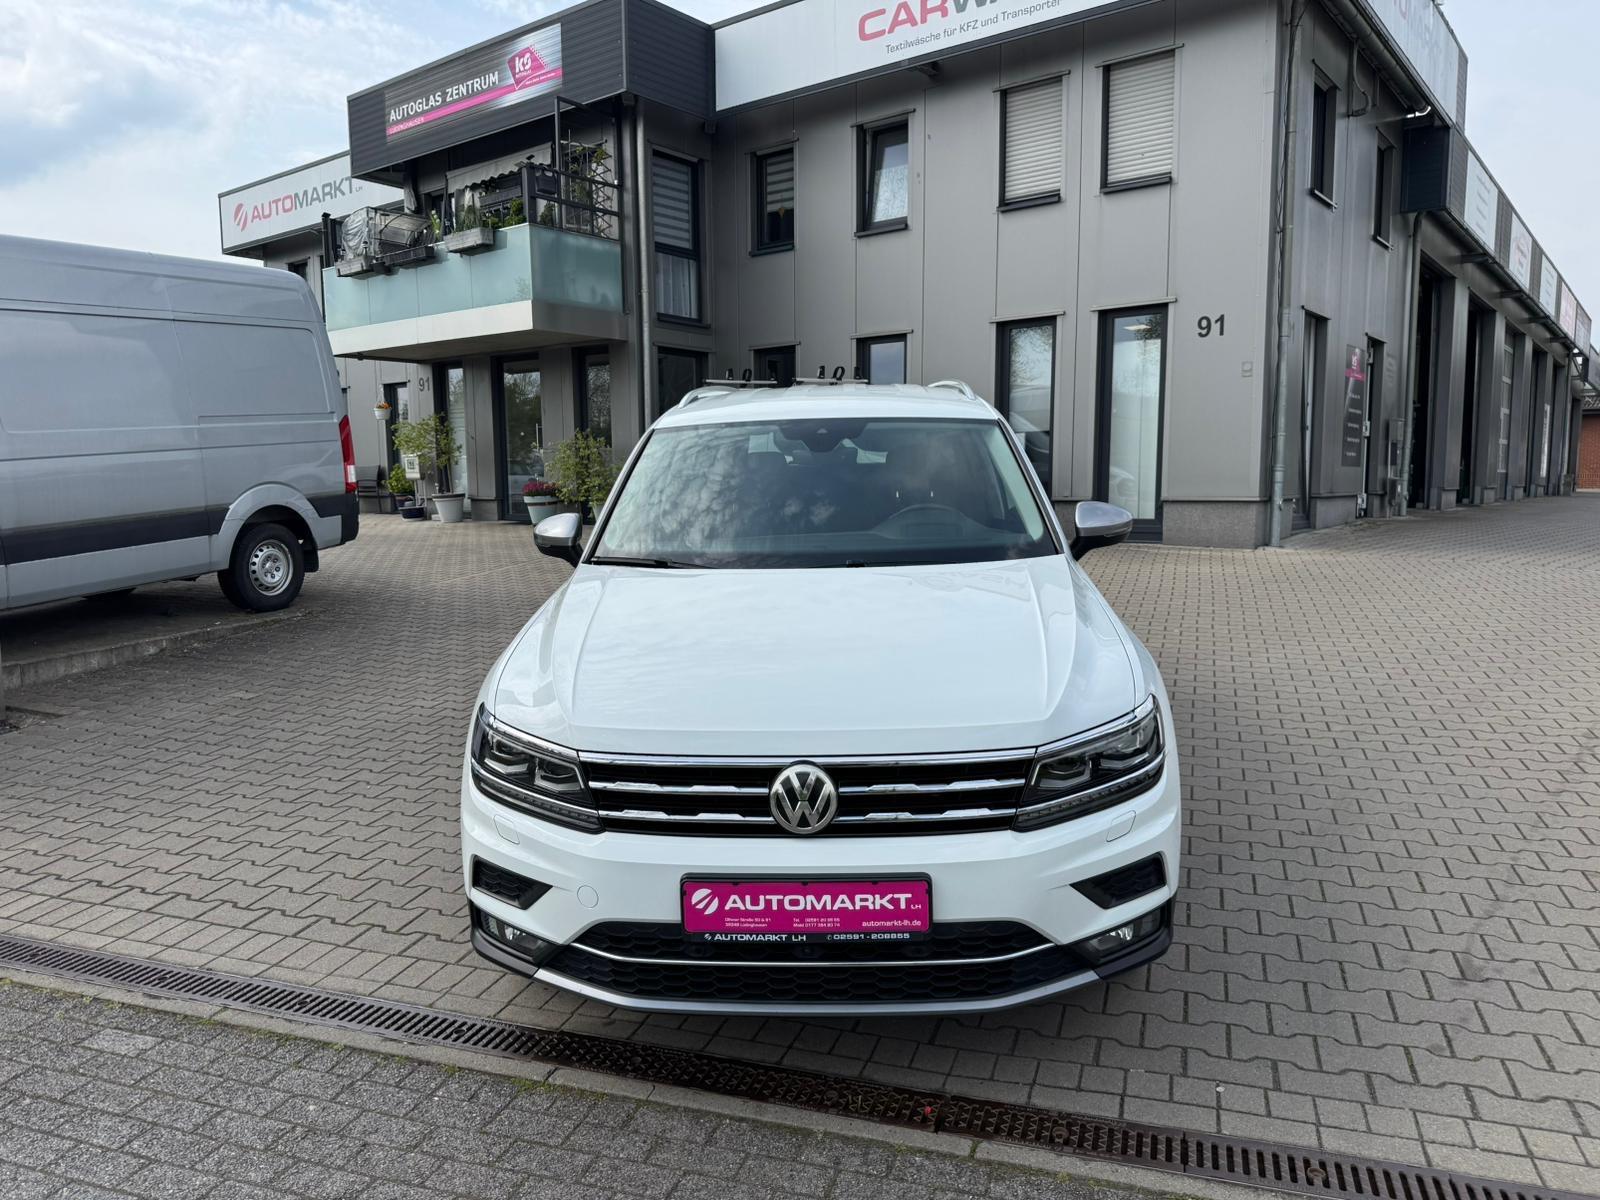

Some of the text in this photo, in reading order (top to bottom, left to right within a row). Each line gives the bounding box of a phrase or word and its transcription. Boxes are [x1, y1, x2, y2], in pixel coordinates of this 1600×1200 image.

[859, 0, 997, 41] CAR
[886, 0, 1062, 54] Textilwäsche für KFZ und Transporter
[389, 71, 499, 122] AUTOGLAS ZENTRUM
[250, 175, 354, 223] AUTOMARKT
[1197, 313, 1225, 338] 91
[418, 375, 430, 392] 91
[724, 893, 912, 911] AUTOMARKT
[862, 919, 922, 927] automarkt-lh.de
